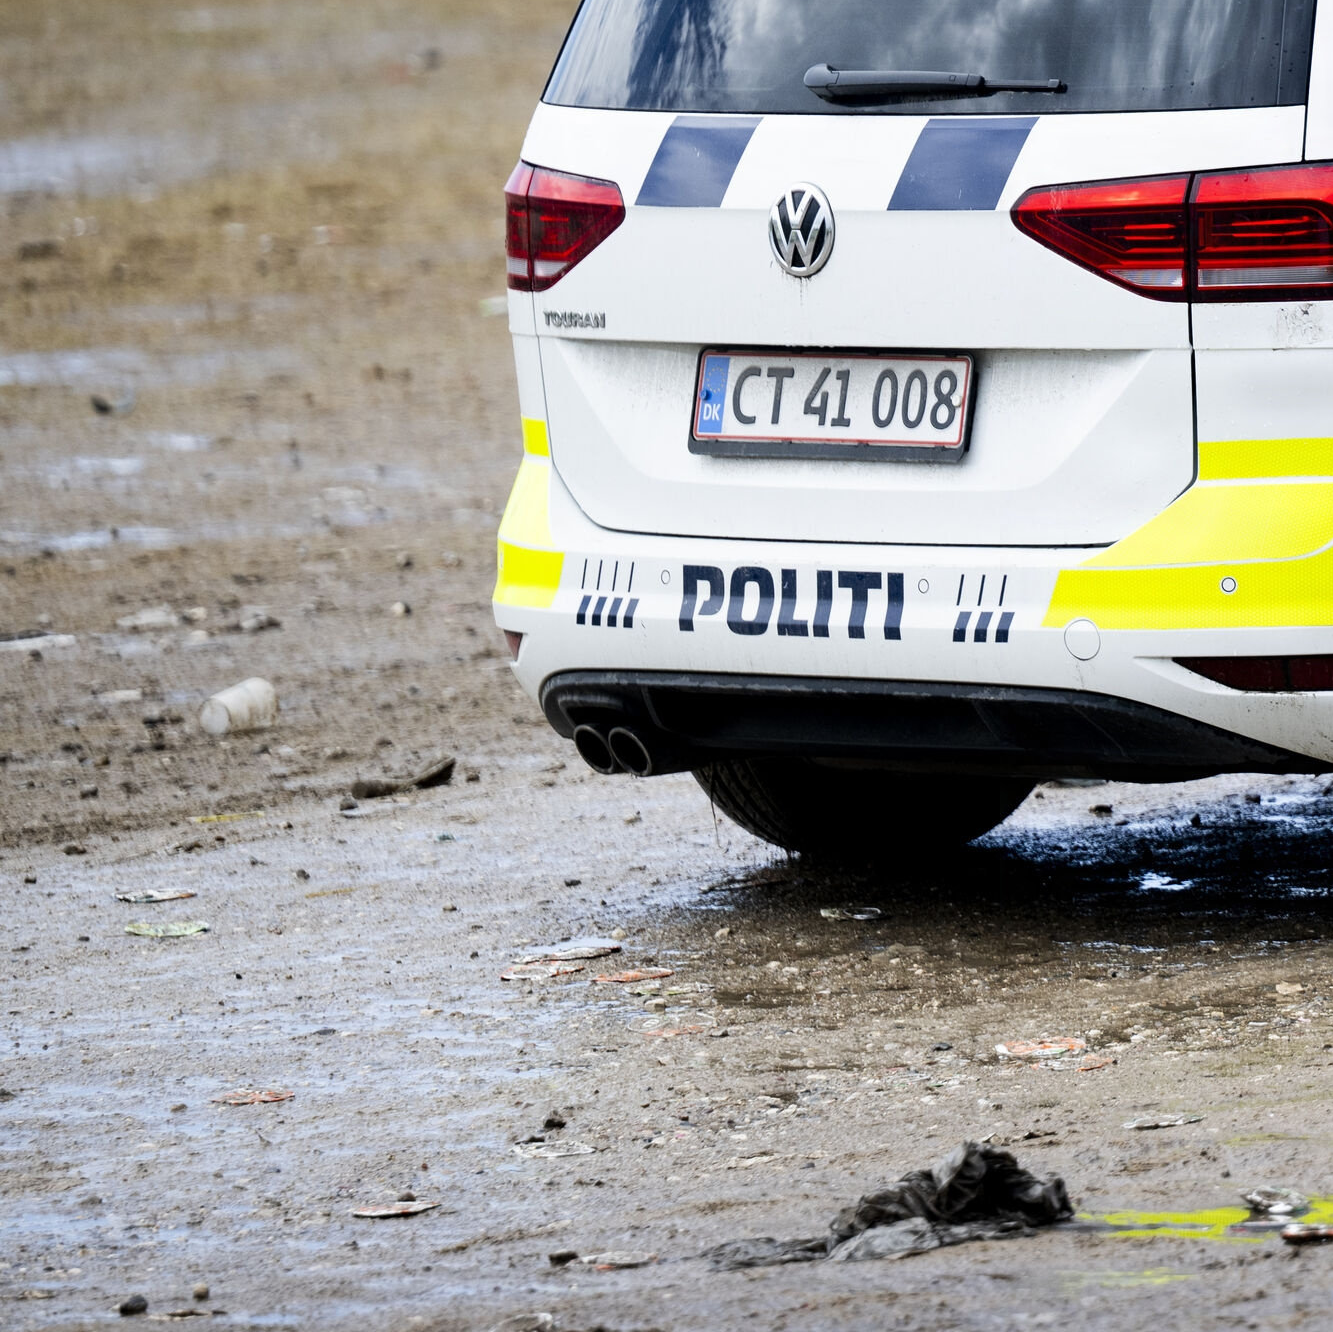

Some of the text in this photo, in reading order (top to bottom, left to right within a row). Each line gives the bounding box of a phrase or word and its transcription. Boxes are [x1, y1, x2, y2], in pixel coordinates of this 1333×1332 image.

[543, 310, 606, 329] TOURAN
[703, 403, 720, 421] DK
[732, 367, 958, 430] CT 41 008
[678, 564, 905, 641] POLITI
